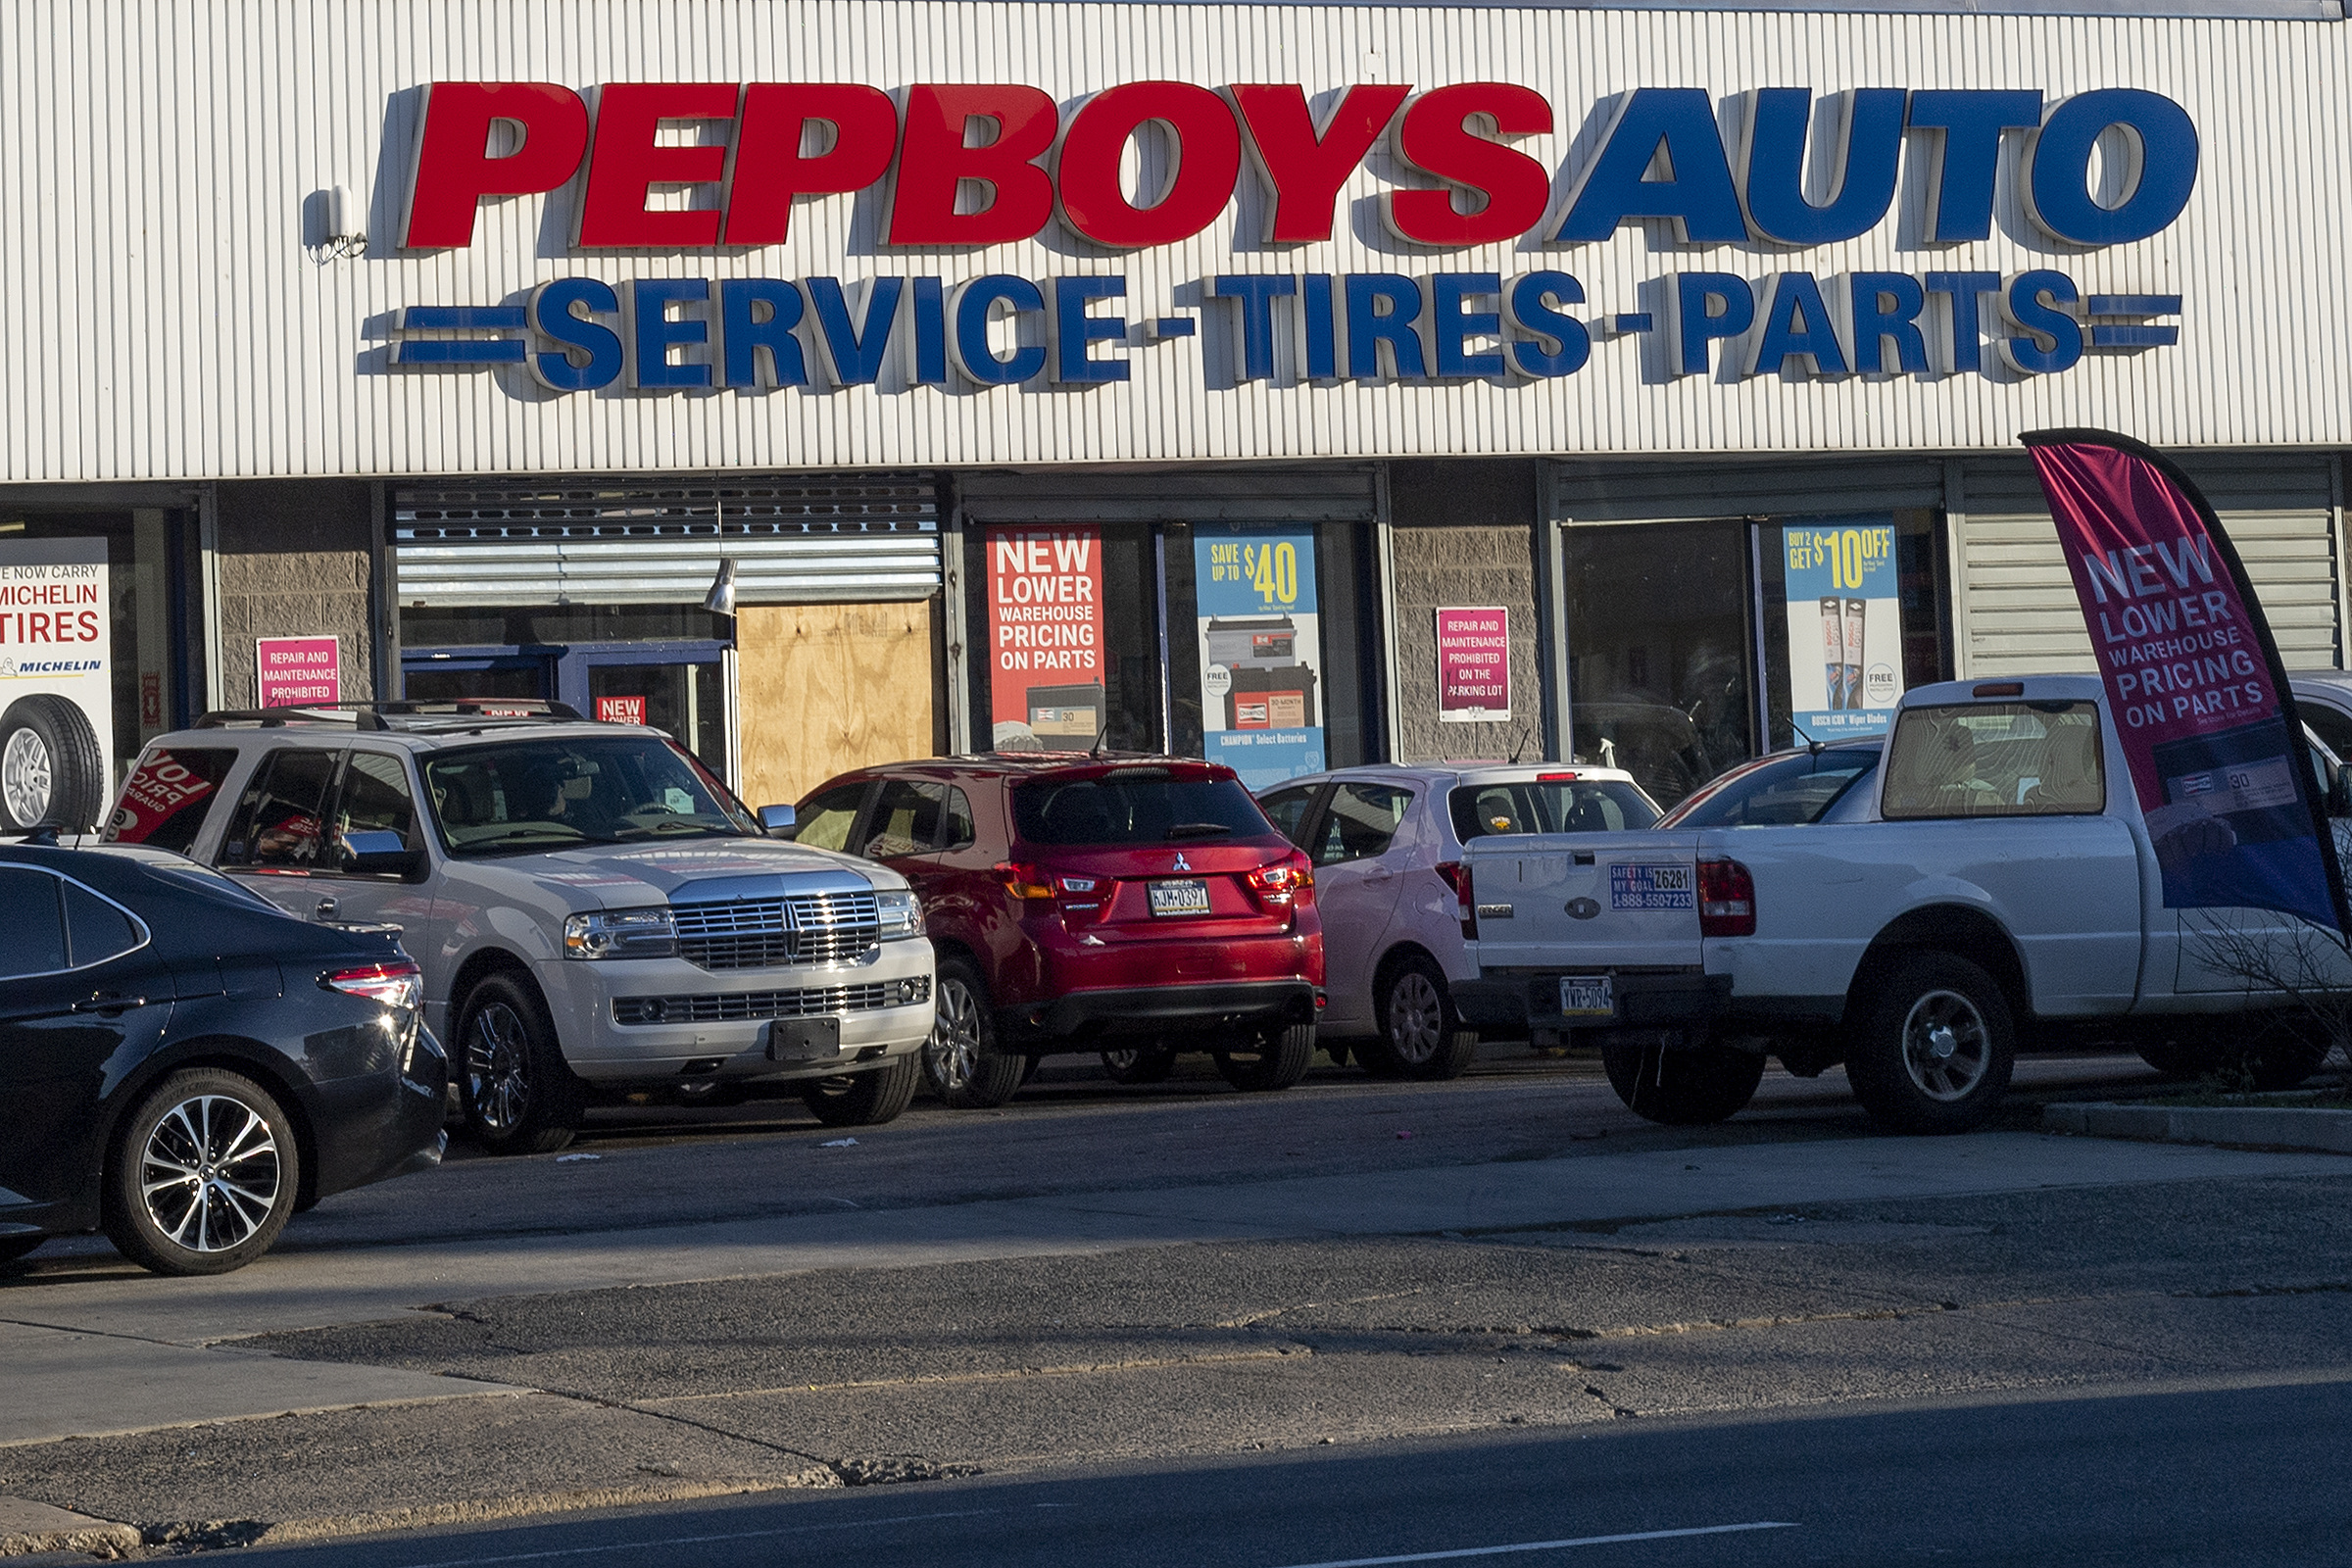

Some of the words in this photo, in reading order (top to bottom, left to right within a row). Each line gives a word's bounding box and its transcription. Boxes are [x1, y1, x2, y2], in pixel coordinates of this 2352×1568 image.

[1554, 86, 2199, 245] AUTO
[1788, 532, 1804, 547] BUY
[1805, 531, 1811, 546] 2
[996, 532, 1091, 573] NEW
[1211, 543, 1240, 564] SAVE
[1789, 548, 1812, 569] GET
[1813, 529, 1863, 589] $10
[1861, 528, 1890, 559] OFF
[0, 566, 10, 580] E
[14, 565, 47, 580] NOW
[51, 564, 98, 578] CARRY
[1212, 565, 1225, 581] UP
[1227, 564, 1240, 581] TO
[1244, 542, 1298, 604] $40
[2083, 532, 2214, 604] NEW
[998, 575, 1094, 604] LOWER
[998, 605, 1094, 622] WAREHOUSE
[2099, 590, 2232, 644] LOWER
[0, 611, 99, 644] TIRES
[1447, 620, 1479, 632] REPAIR
[1480, 620, 1499, 631] AND
[999, 623, 1095, 648] PRICING
[1442, 636, 1506, 648] MAINTENANCE
[2108, 626, 2241, 668] WAREHOUSE
[20, 660, 102, 672] MICHELIN
[270, 652, 305, 664] REPAIR
[307, 651, 329, 663] AND
[1001, 650, 1028, 670] ON
[1034, 649, 1096, 669] PARTS
[1448, 653, 1500, 664] PROHIBITED
[264, 668, 337, 682] MAINTENANCE
[1458, 668, 1472, 680] ON
[1474, 668, 1491, 680] THE
[1869, 672, 1893, 683] FREE
[2116, 650, 2255, 701] PRICING
[271, 686, 330, 699] PROHIBITED
[1447, 685, 1486, 697] PARKING
[1487, 685, 1503, 696] LOT
[602, 700, 641, 716] NEW
[2126, 701, 2166, 728] ON
[2173, 681, 2263, 719] PARTS
[1062, 711, 1075, 722] 30
[1255, 733, 1277, 745] Select
[1277, 732, 1307, 744] Batteries
[2230, 773, 2250, 790] 30
[1611, 866, 1642, 879] SAFETY
[1645, 866, 1653, 879] IS
[1613, 880, 1626, 892] MY
[1630, 880, 1653, 892] GOAL
